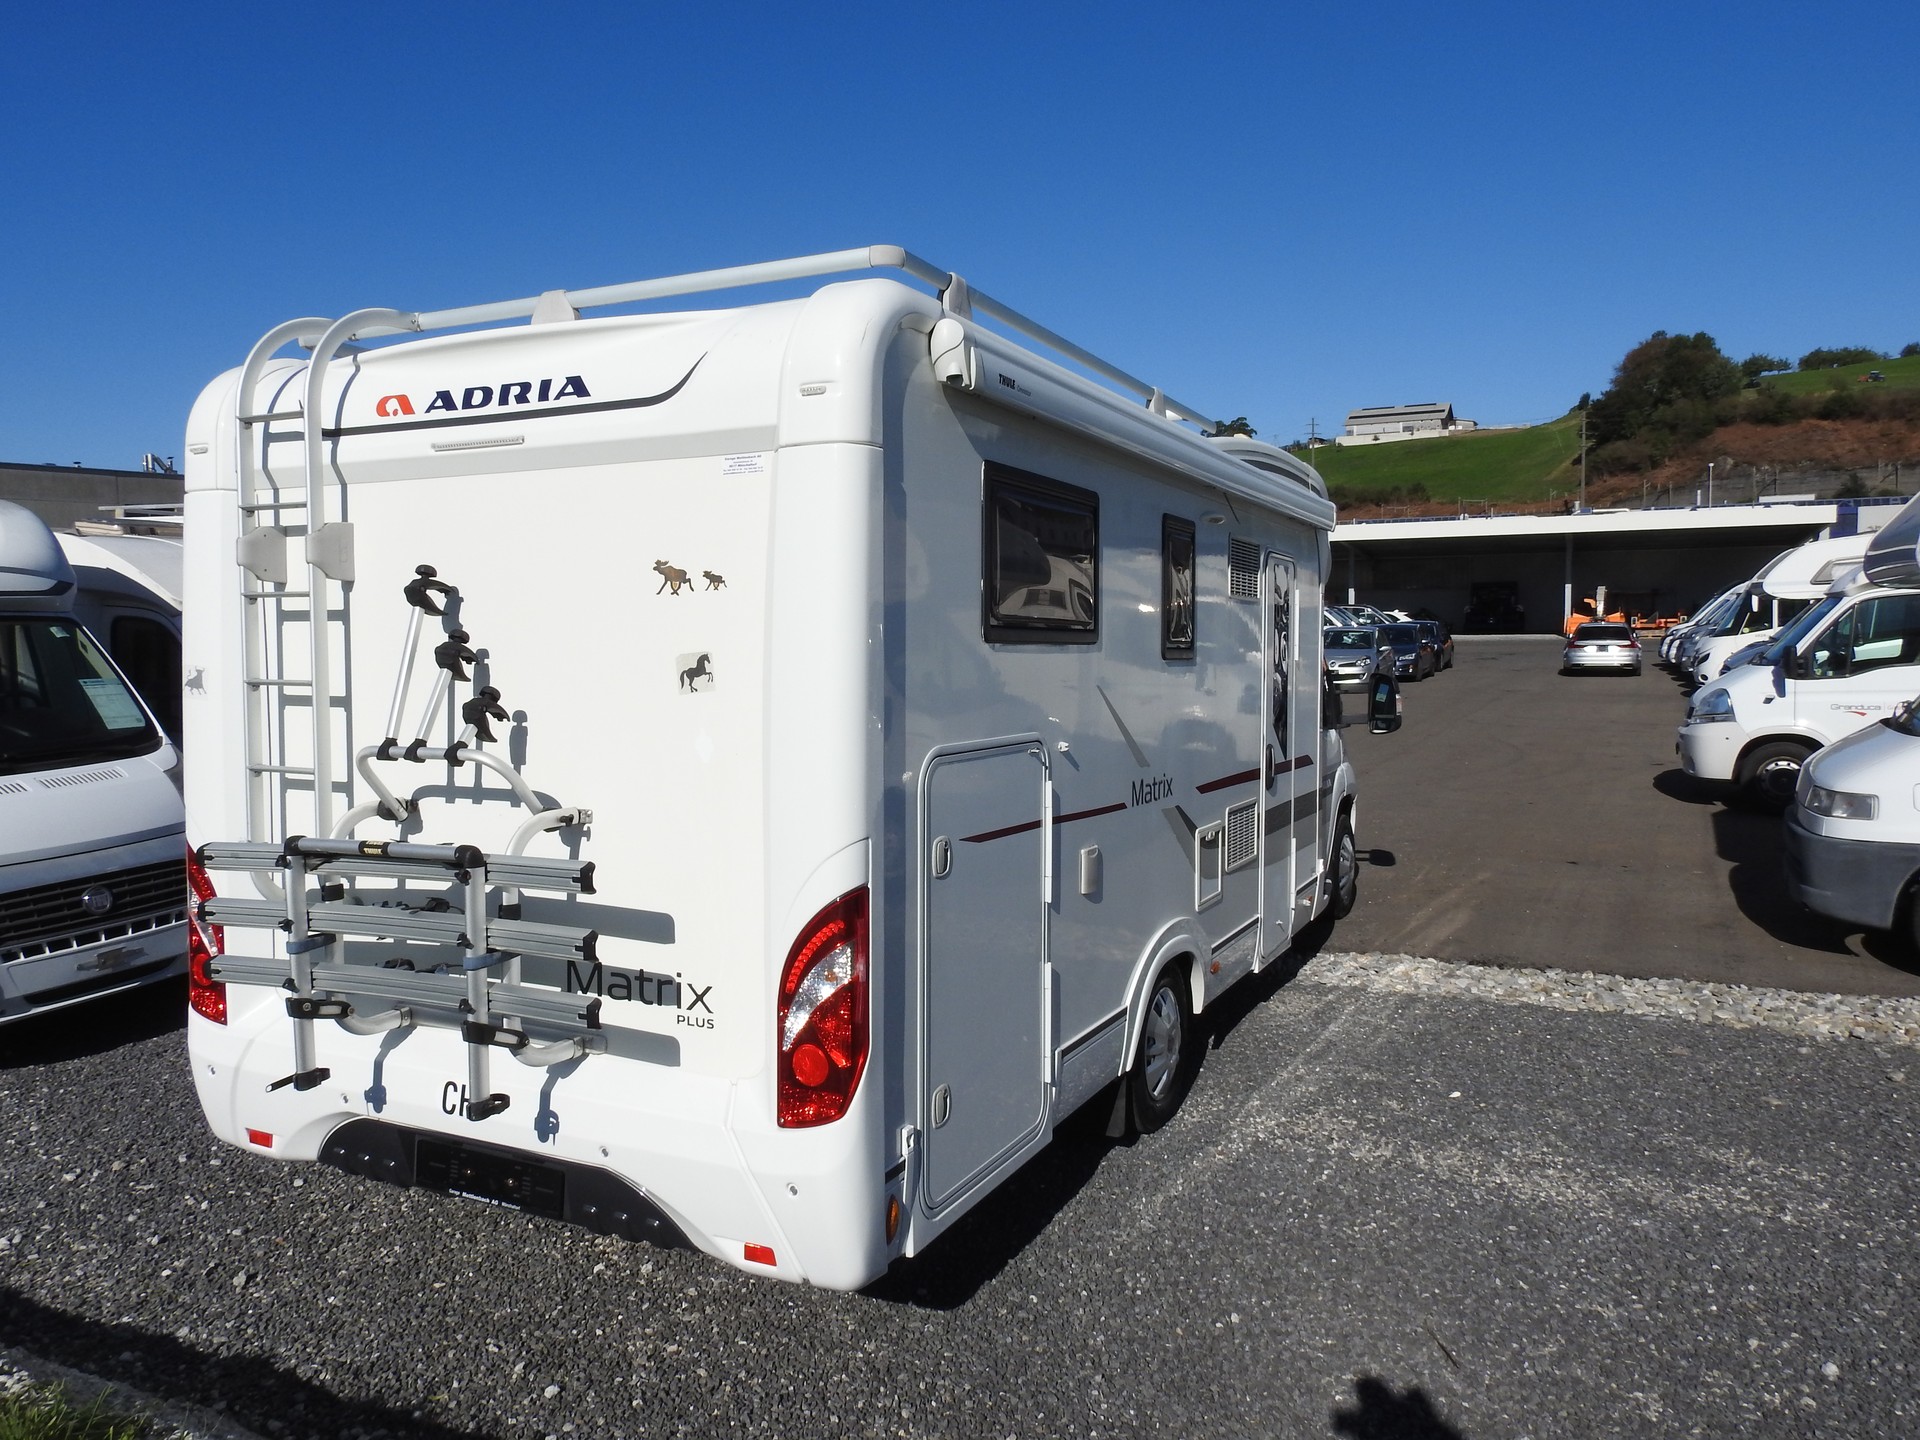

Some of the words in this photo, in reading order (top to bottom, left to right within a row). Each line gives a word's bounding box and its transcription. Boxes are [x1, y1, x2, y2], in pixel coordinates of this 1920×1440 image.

[424, 375, 592, 414] ADRIA
[999, 373, 1016, 390] THULE
[1131, 772, 1173, 808] Matrix
[566, 960, 714, 1014] Matrix
[676, 1014, 715, 1030] PLUS
